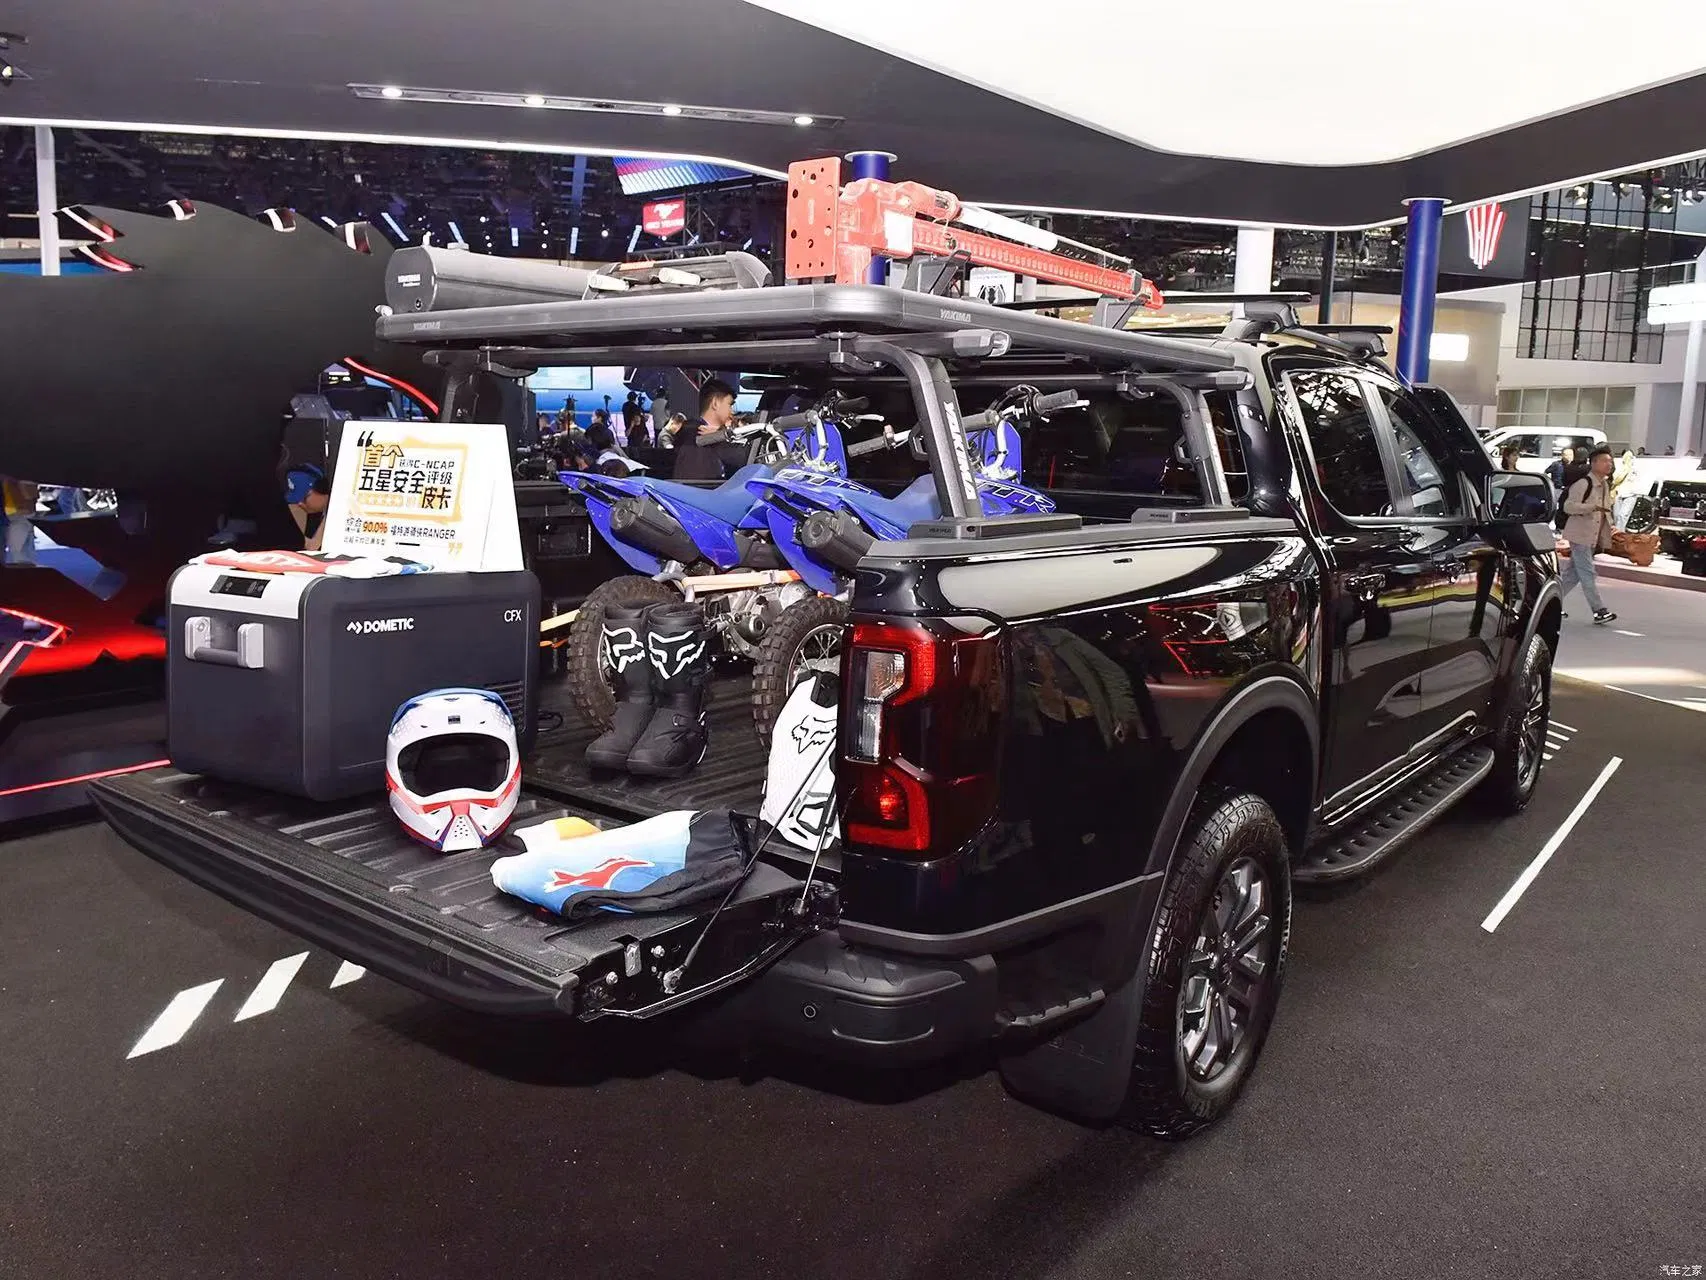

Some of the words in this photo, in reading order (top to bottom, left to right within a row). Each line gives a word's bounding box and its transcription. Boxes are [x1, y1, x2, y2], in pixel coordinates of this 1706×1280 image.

[940, 308, 972, 323] YAKIMA
[362, 443, 405, 469] 首个
[943, 401, 977, 500] YAKIMA
[362, 520, 388, 534] 90.0%
[503, 609, 522, 622] CFX
[363, 617, 415, 634] DOMETIC
